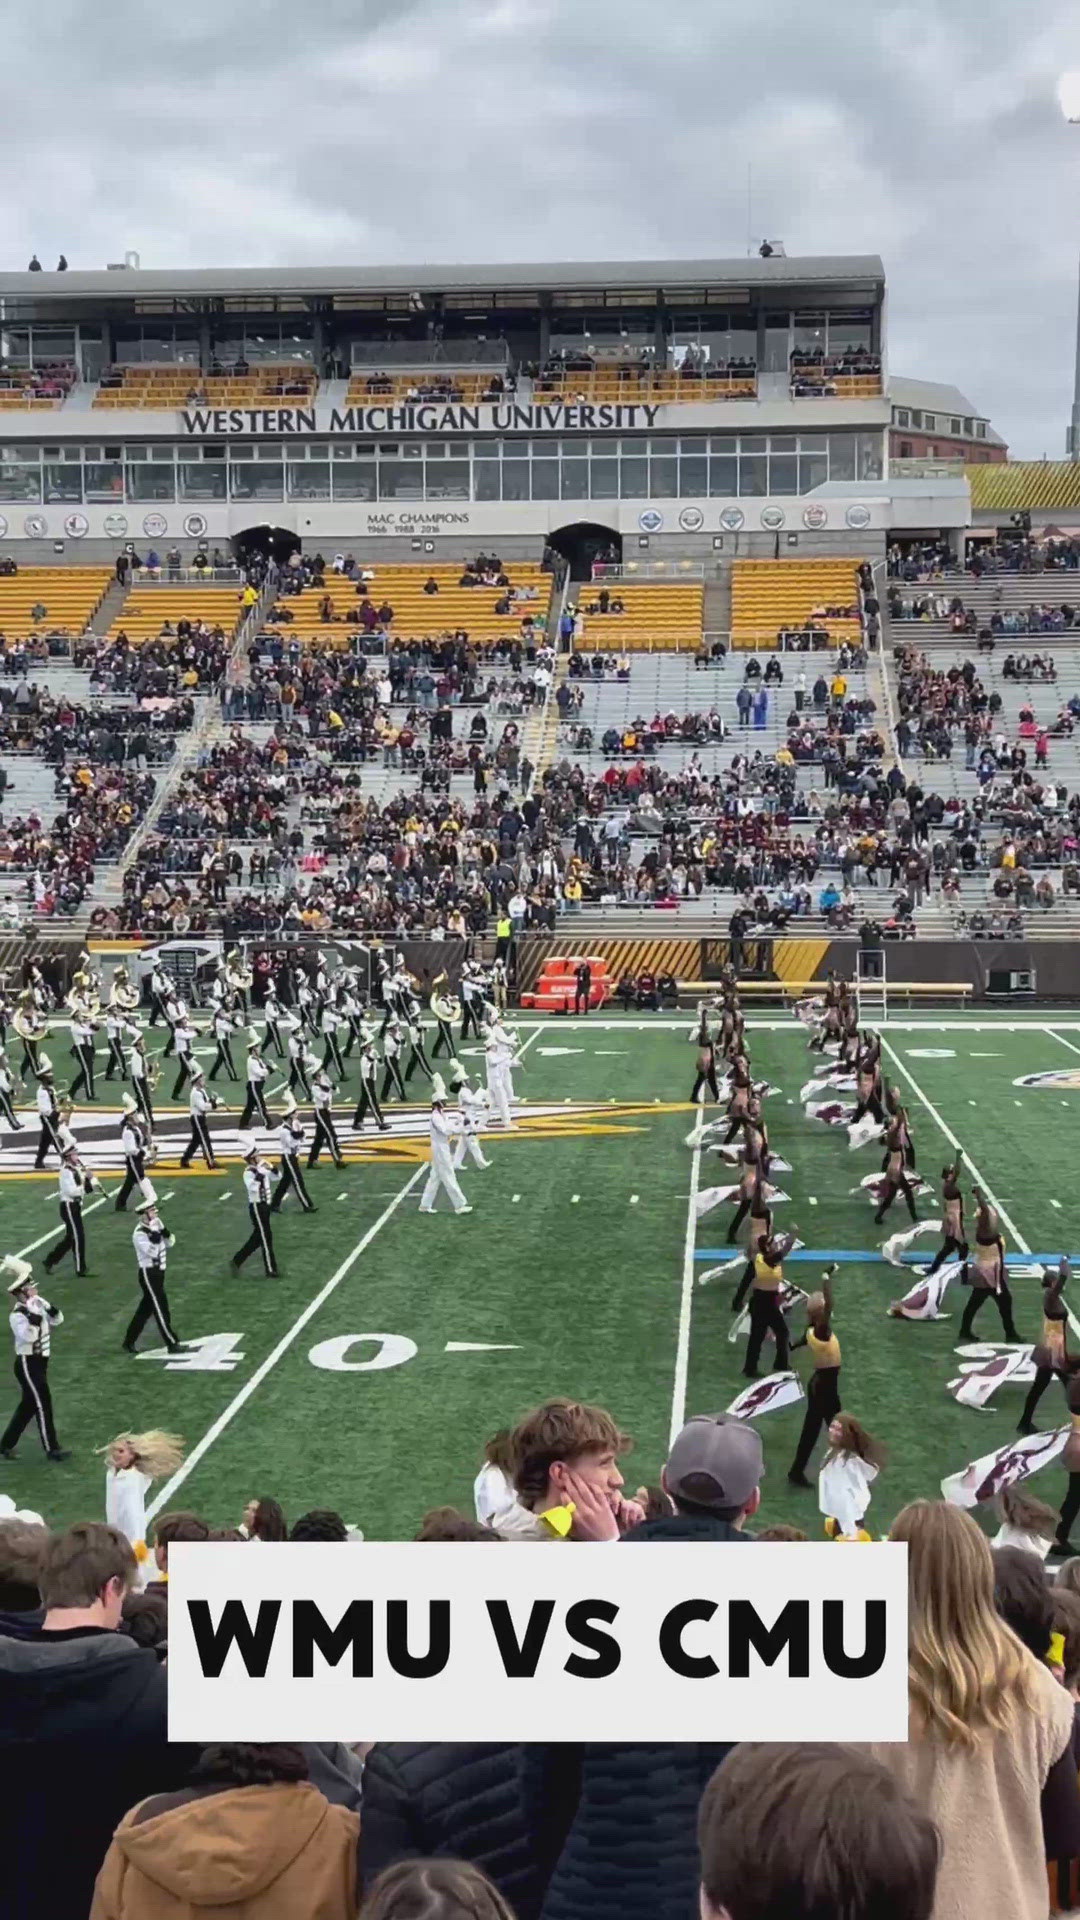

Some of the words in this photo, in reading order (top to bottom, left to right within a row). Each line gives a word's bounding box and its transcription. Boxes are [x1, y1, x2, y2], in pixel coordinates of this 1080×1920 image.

[183, 407, 317, 433] WESTERN
[330, 405, 480, 431] MICHIGAN
[492, 404, 662, 429] UNIVERSITY
[367, 513, 395, 524] MAC
[399, 512, 470, 523] CHAMPIONS
[126, 544, 133, 553] C
